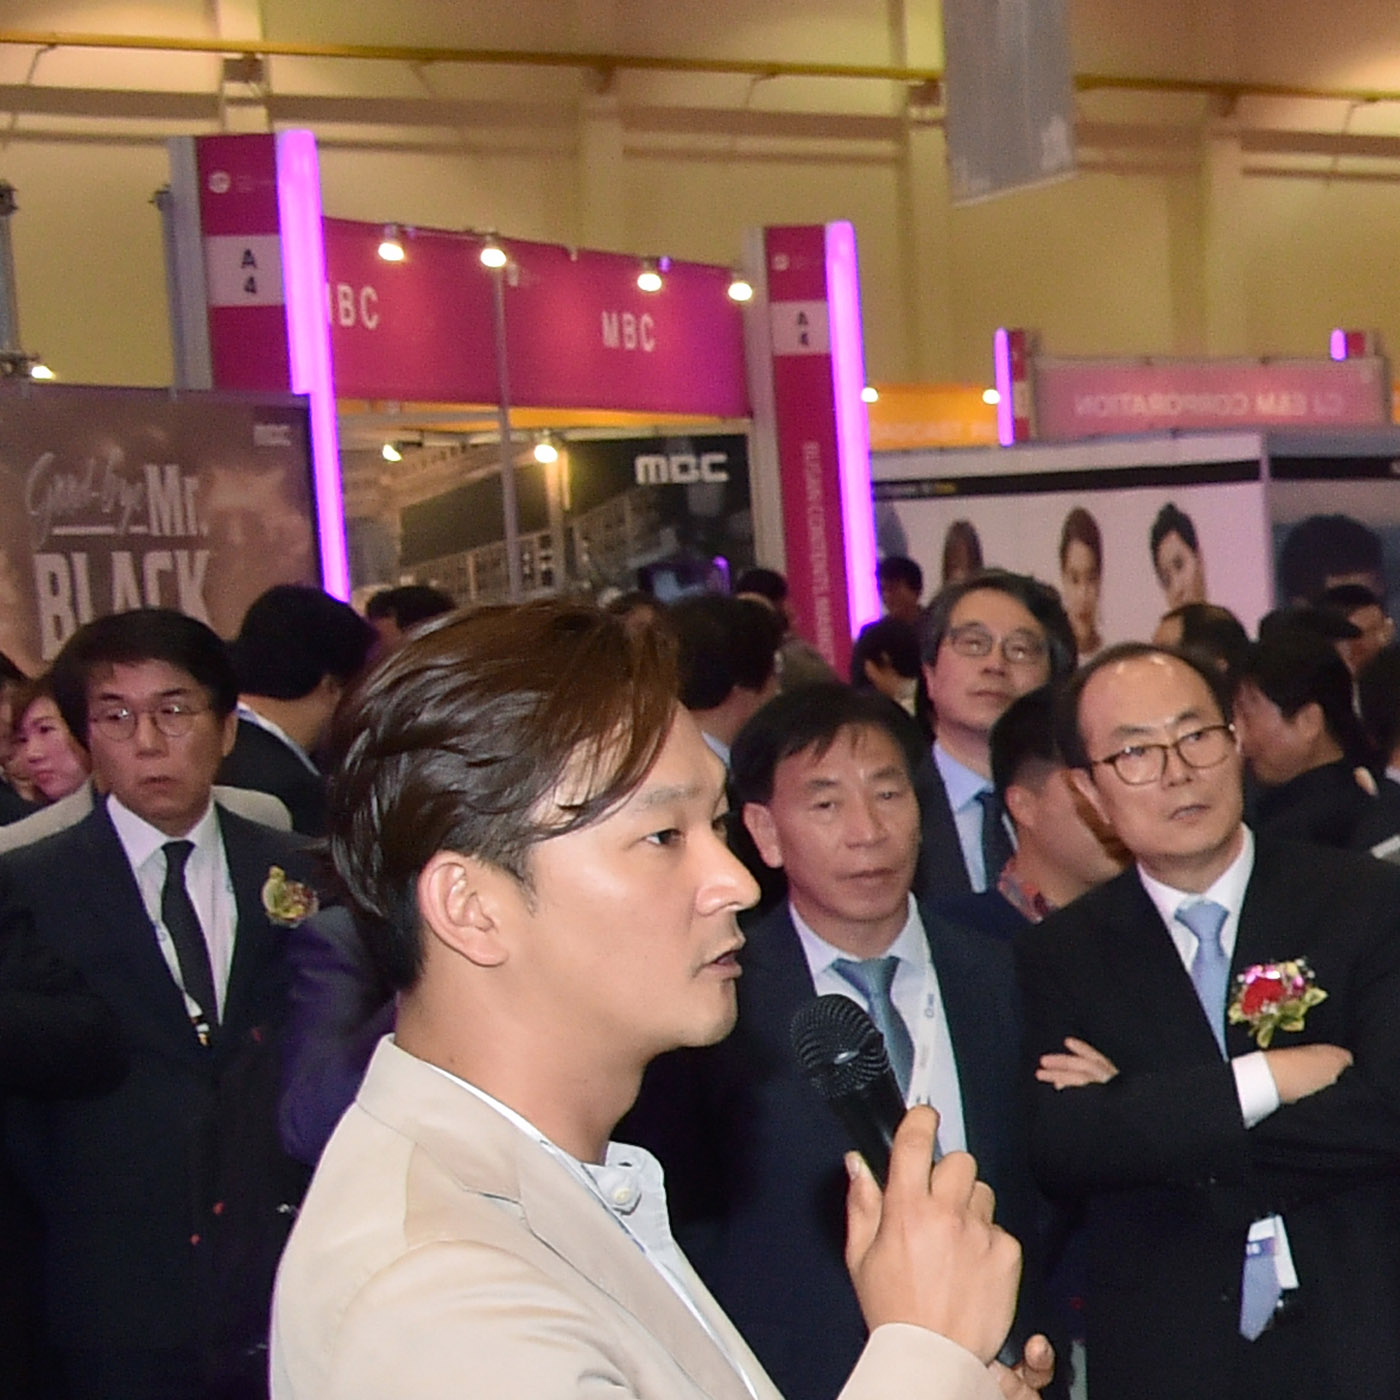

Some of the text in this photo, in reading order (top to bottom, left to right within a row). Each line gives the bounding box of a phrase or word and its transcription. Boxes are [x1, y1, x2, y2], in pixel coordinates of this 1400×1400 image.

[328, 284, 379, 329] BC
[601, 310, 655, 353] MBC
[634, 452, 729, 485] MBC
[143, 463, 209, 537] Mr.
